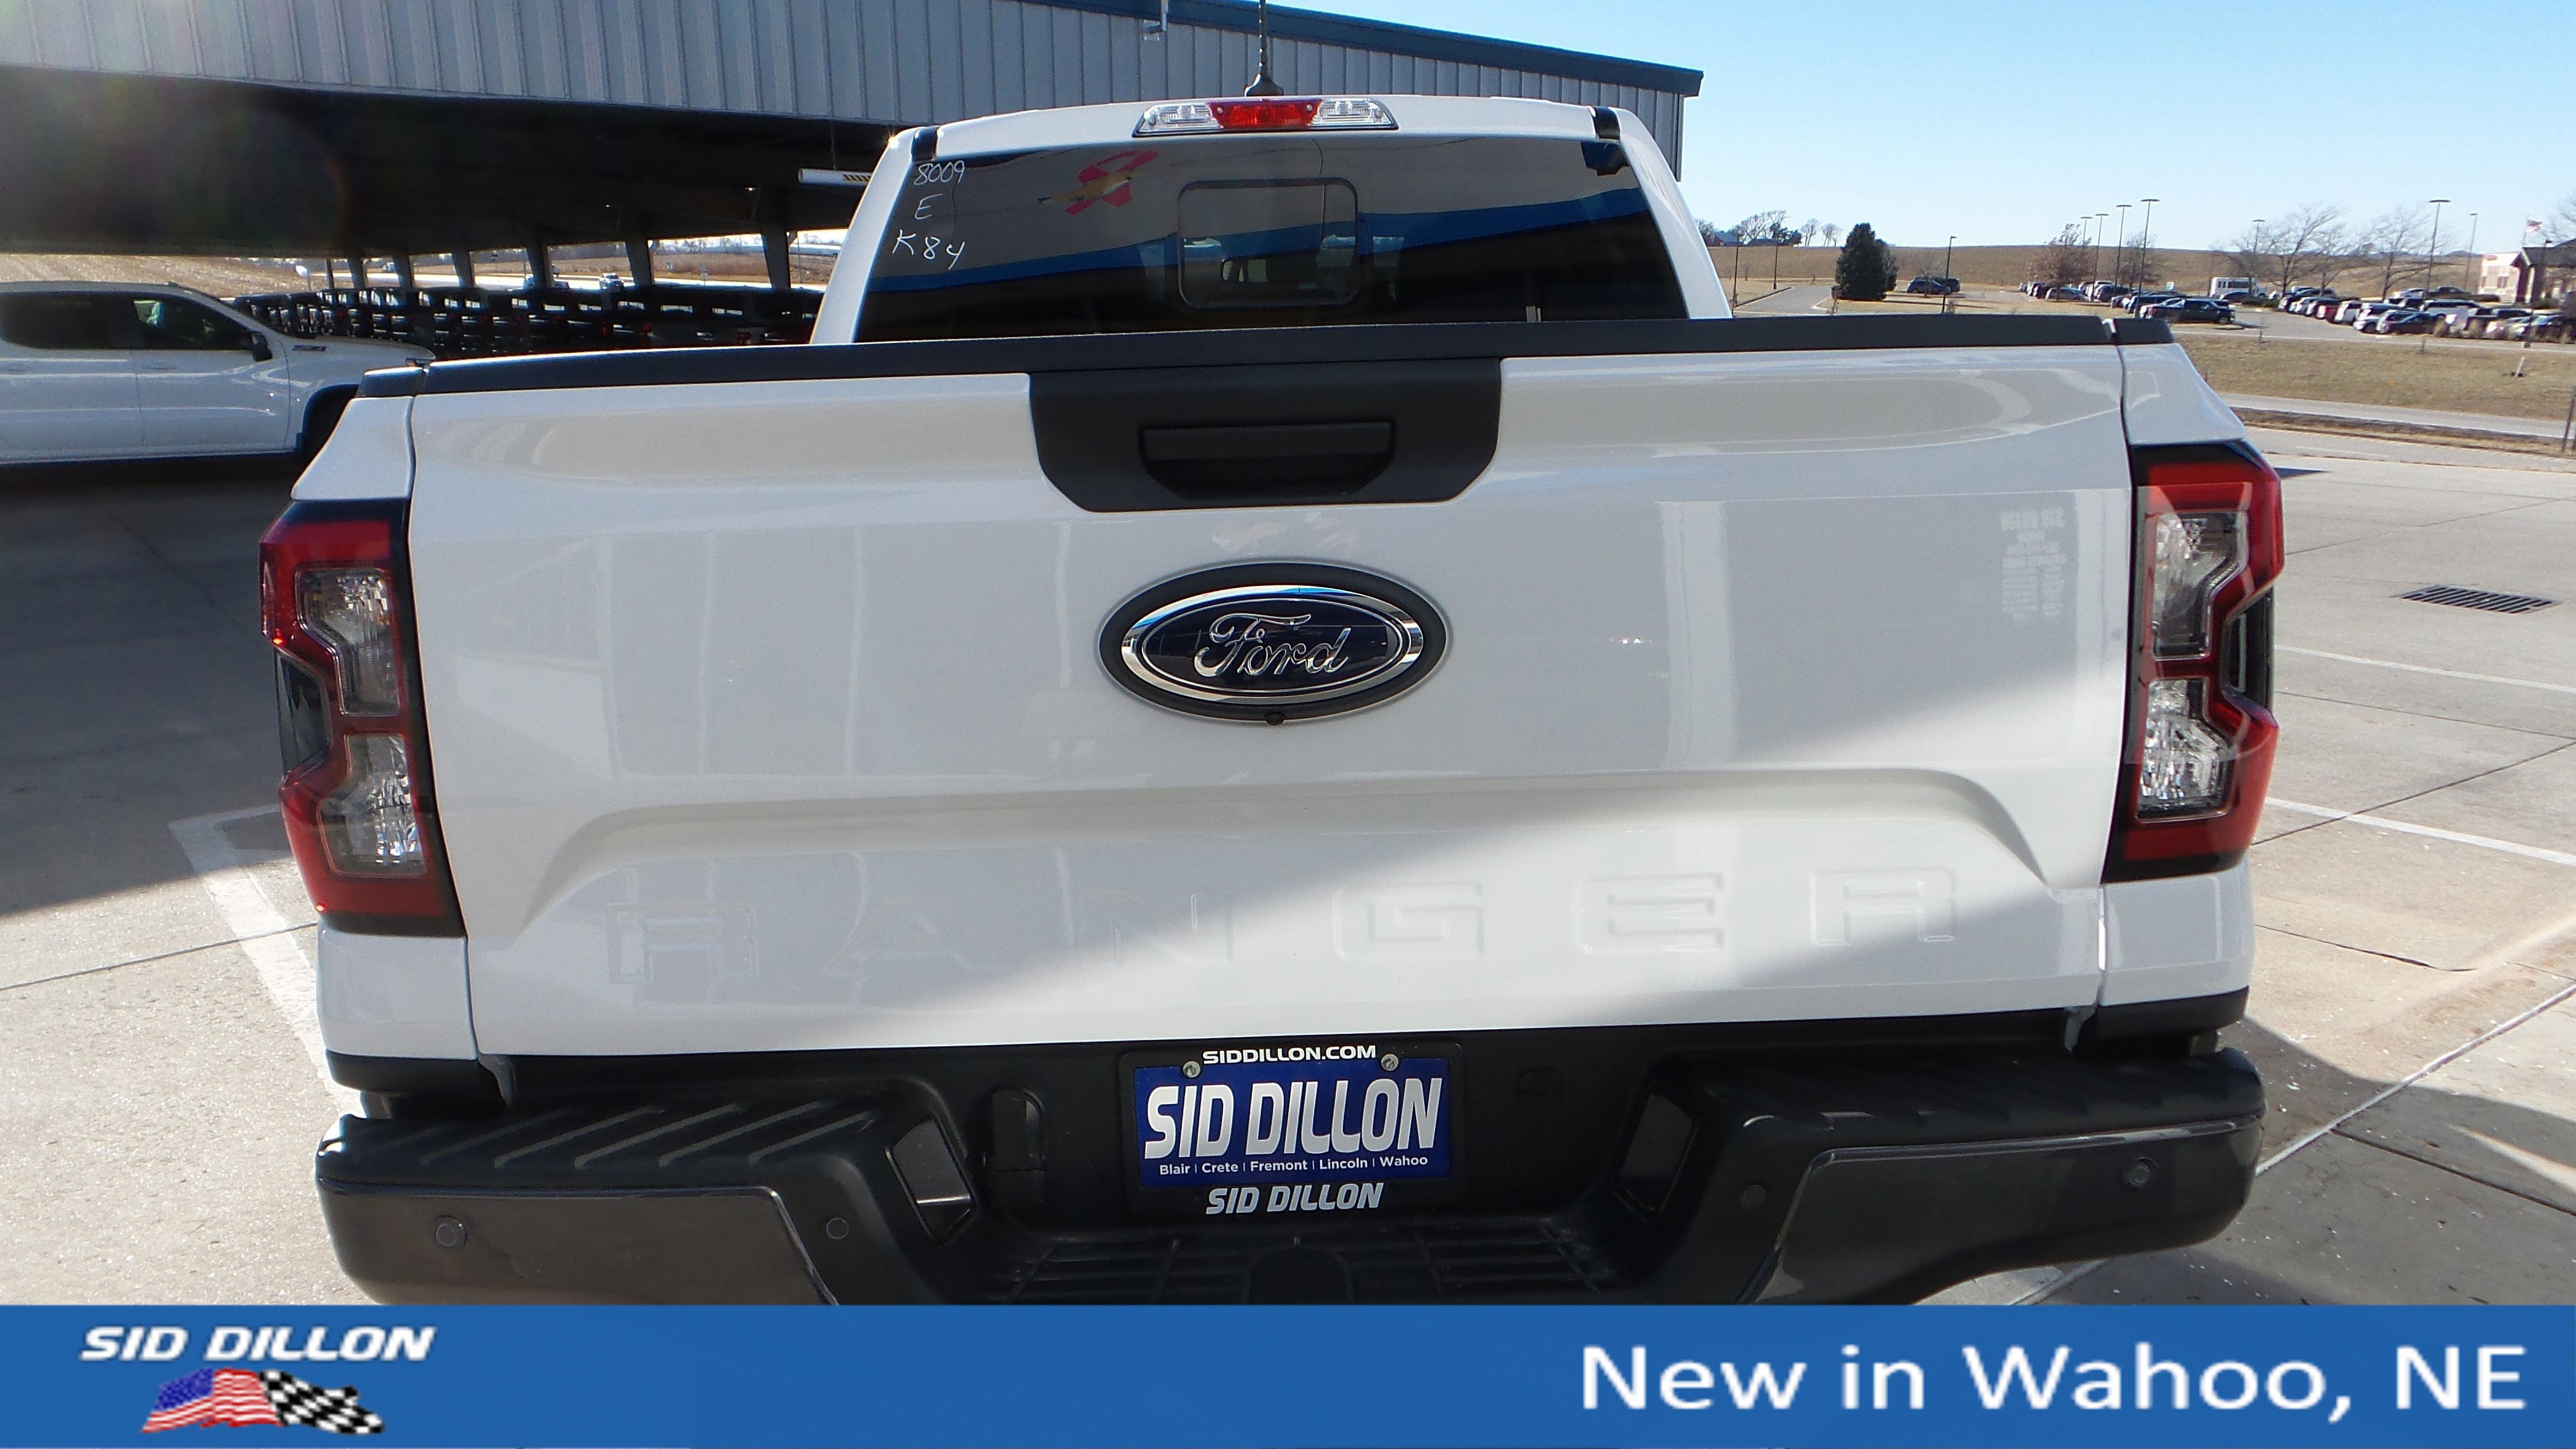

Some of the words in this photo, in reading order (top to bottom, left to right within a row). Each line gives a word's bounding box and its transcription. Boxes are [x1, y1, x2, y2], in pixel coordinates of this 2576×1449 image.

[913, 160, 965, 185] 8009
[915, 193, 943, 220] E
[1194, 613, 1351, 677] Ford
[608, 866, 1958, 985] RANGER
[1202, 1045, 1377, 1064] SIDDILLON.COM
[1144, 1084, 1234, 1159] SID
[1245, 1078, 1442, 1155] DILLON
[1159, 1163, 1191, 1176] Blair
[1201, 1162, 1239, 1175] Crete
[1250, 1159, 1308, 1172] Fremont
[1319, 1157, 1368, 1170] Lincoln
[1379, 1155, 1428, 1168] Wahoo
[1205, 1187, 1260, 1215] SID
[1266, 1182, 1385, 1213] DILLON
